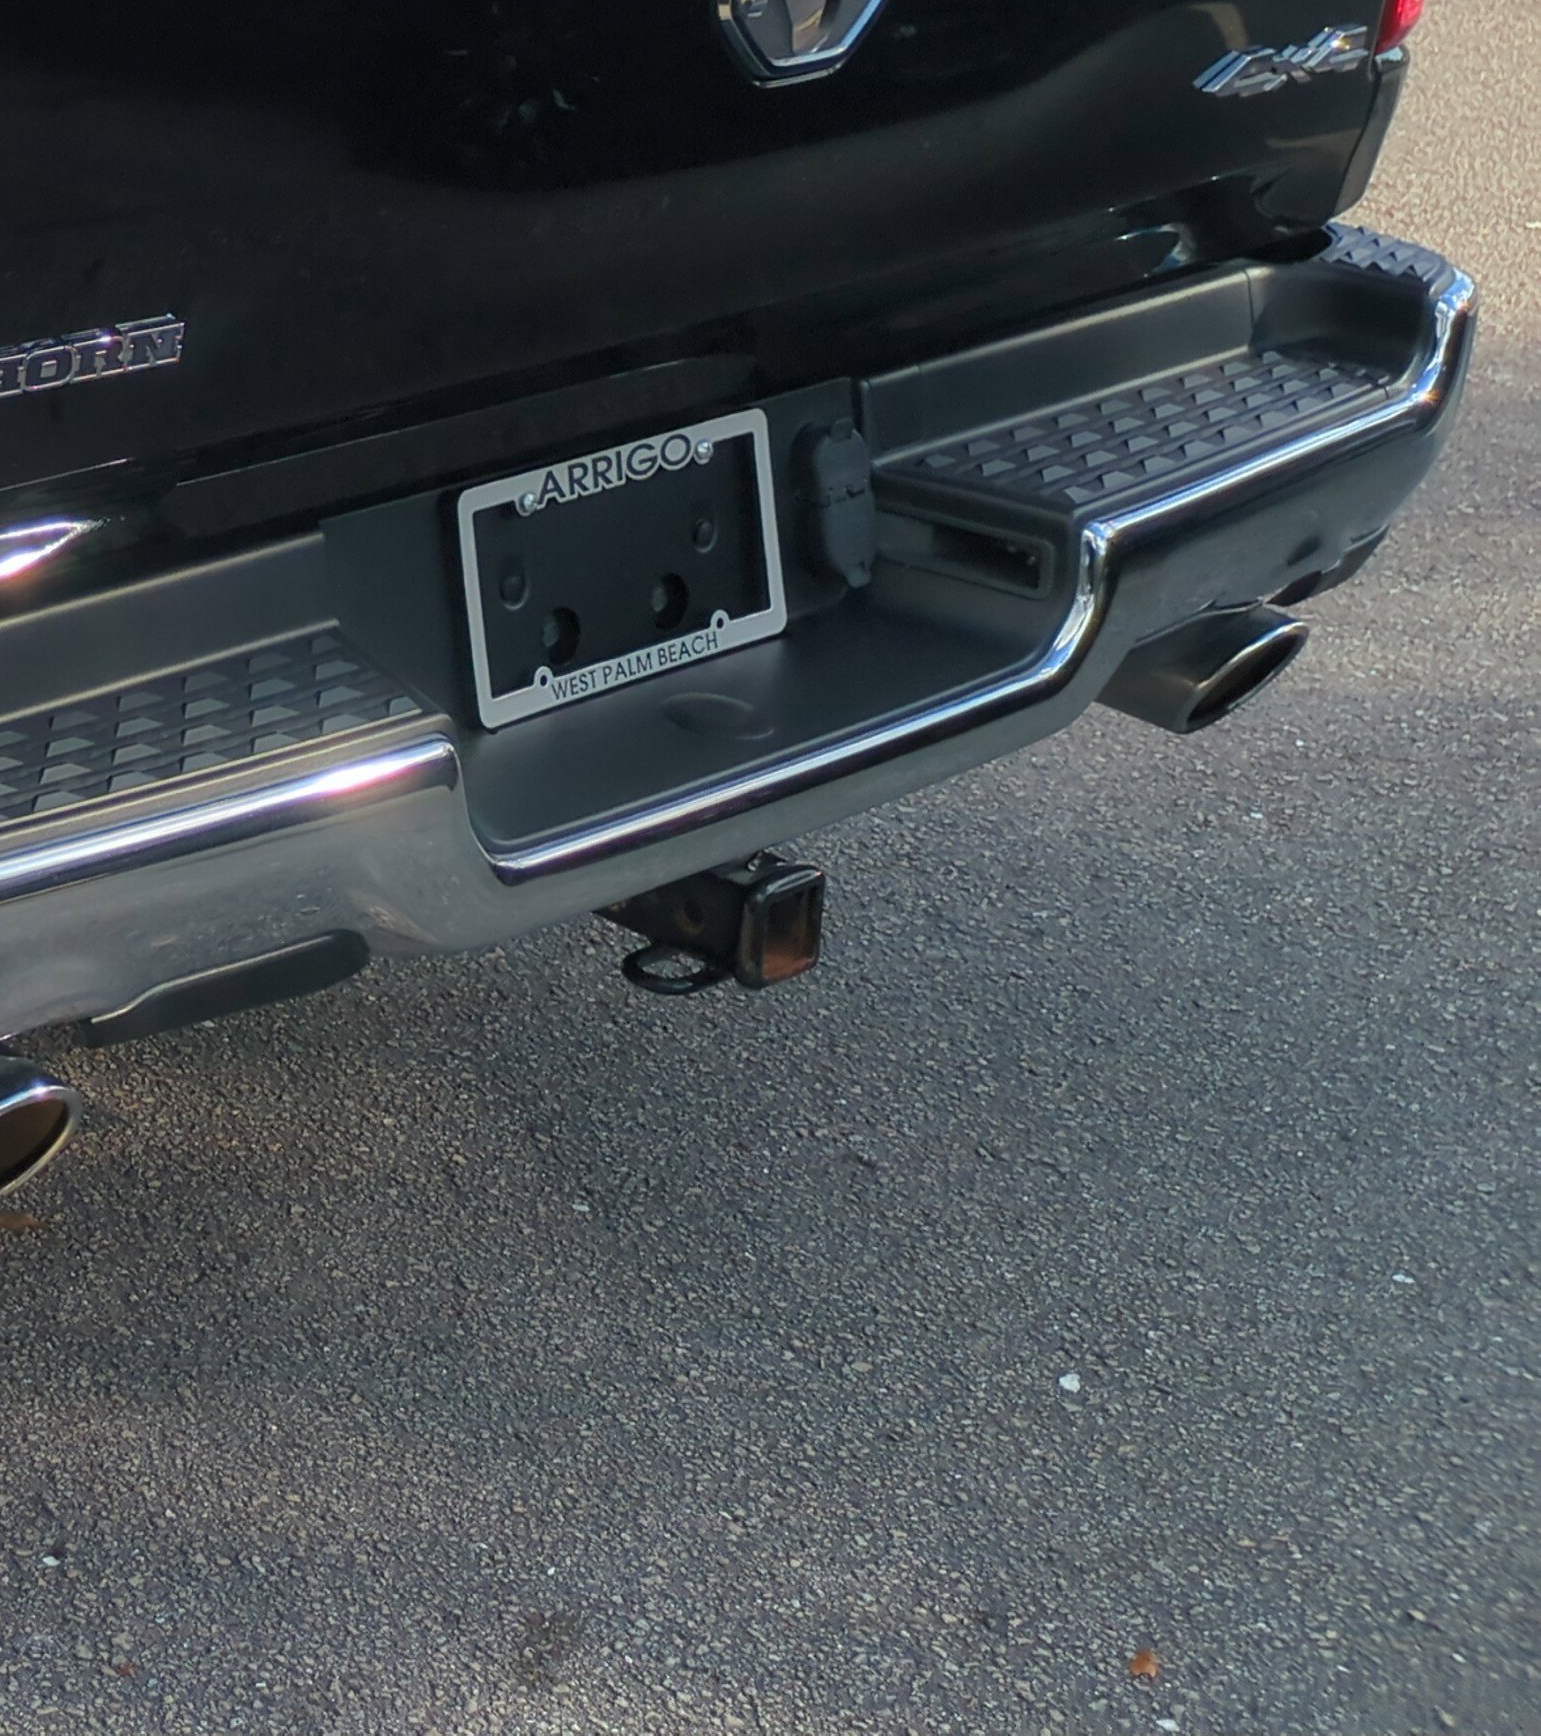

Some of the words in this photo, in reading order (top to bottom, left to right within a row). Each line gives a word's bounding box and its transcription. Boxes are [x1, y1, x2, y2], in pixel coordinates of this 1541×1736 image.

[537, 433, 691, 506] ARRIGO
[551, 669, 598, 701] WEST
[602, 652, 653, 685] PALM
[657, 630, 719, 667] BEACH
